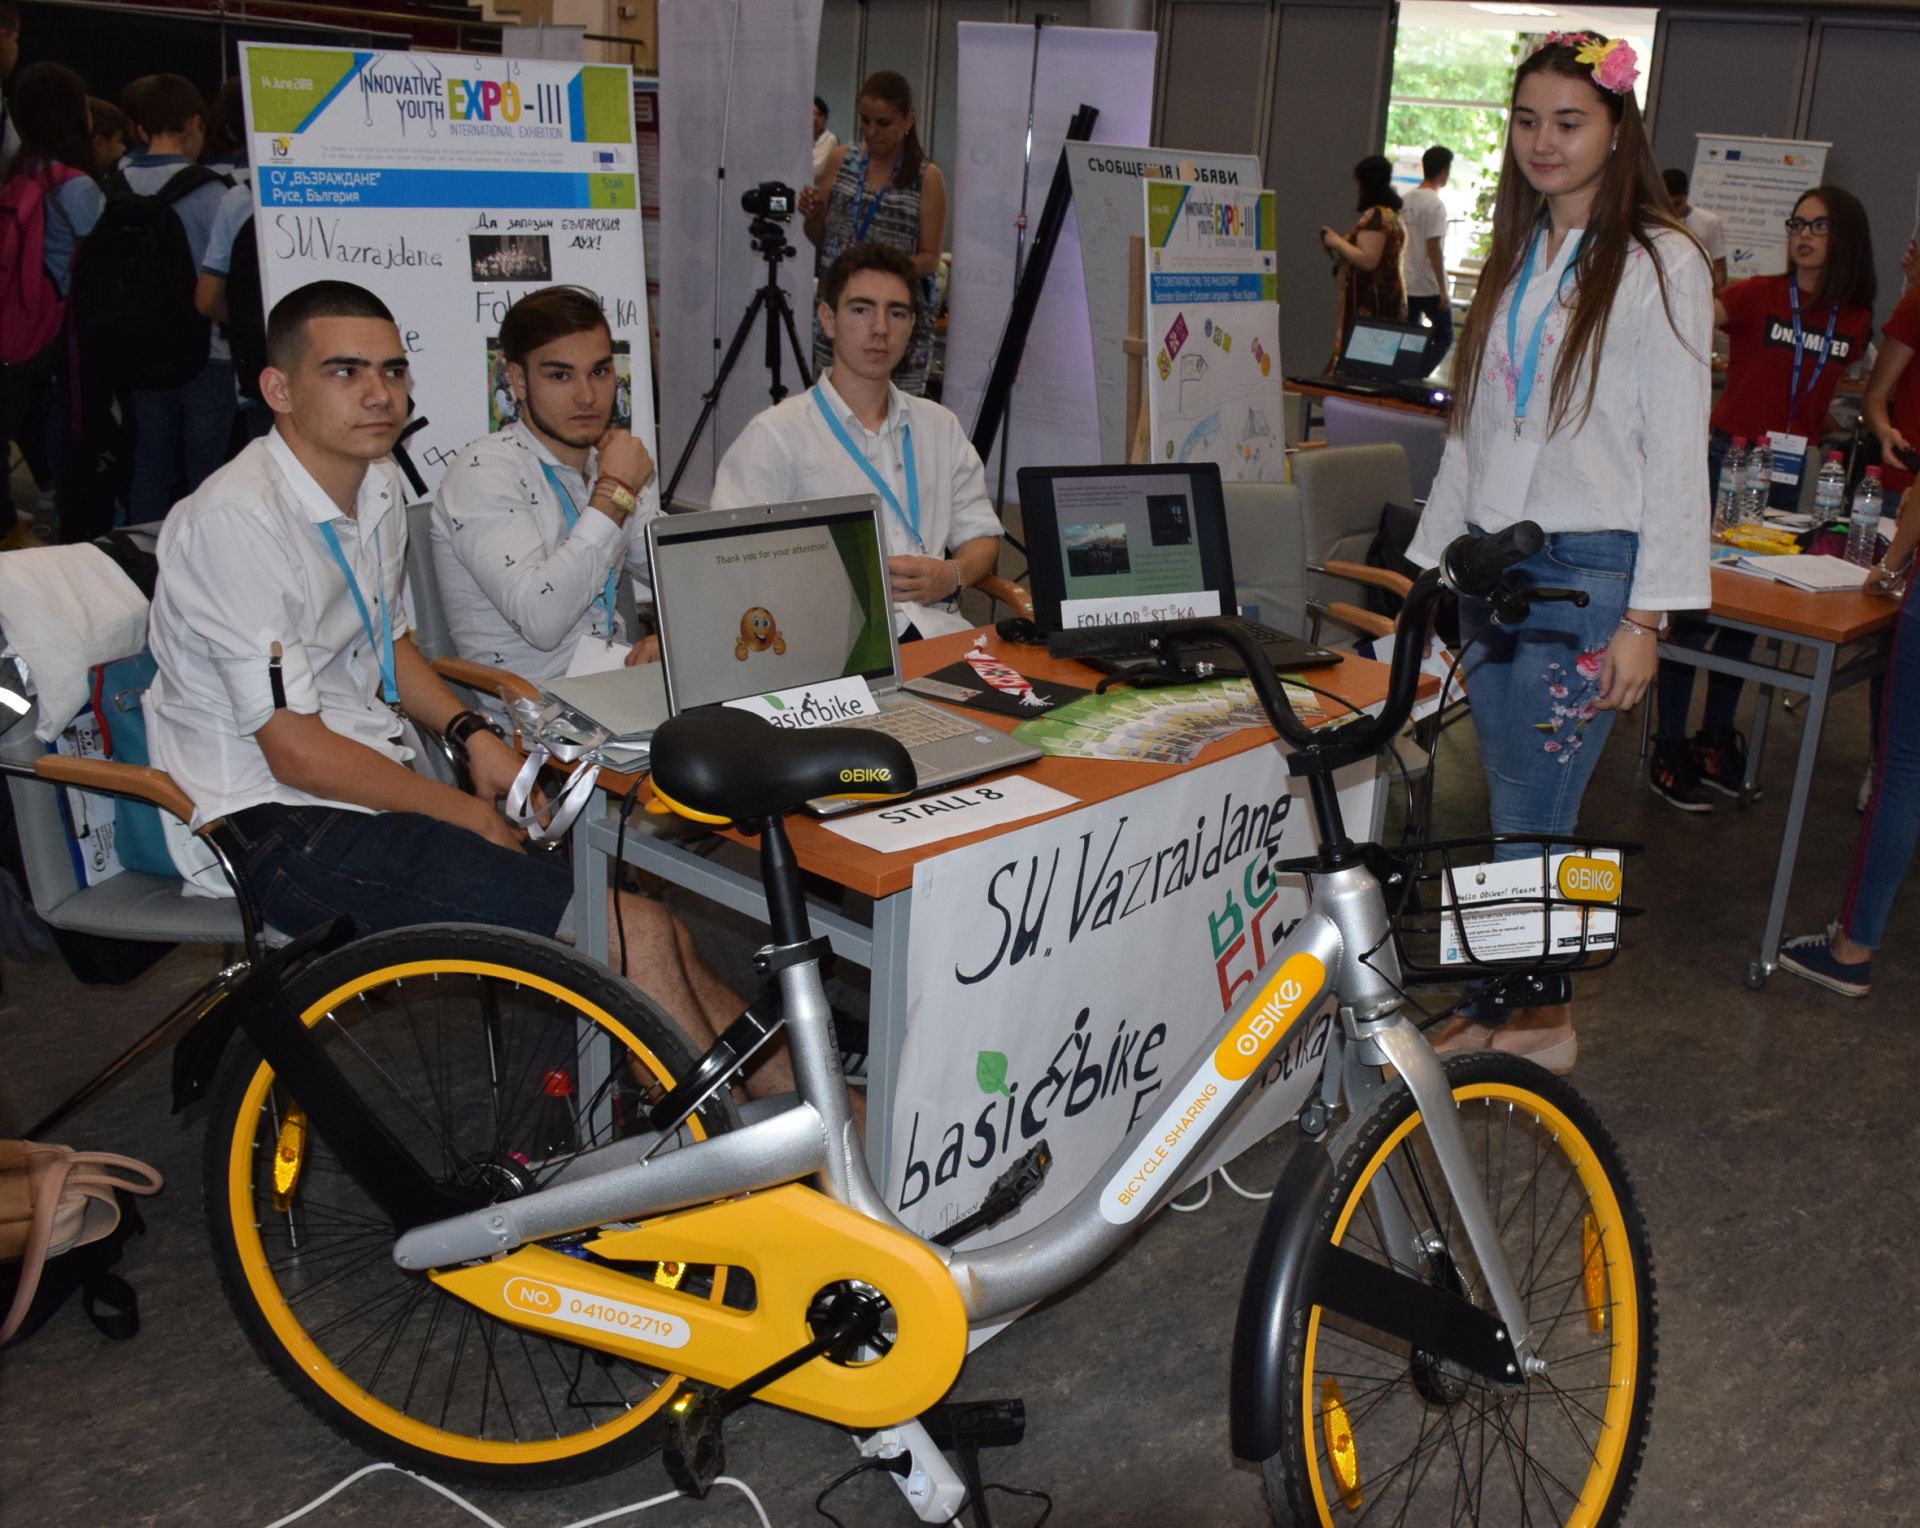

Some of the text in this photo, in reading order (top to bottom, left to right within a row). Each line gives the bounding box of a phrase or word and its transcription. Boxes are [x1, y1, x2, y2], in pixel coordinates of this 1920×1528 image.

[261, 77, 271, 88] 14
[272, 77, 292, 89] June
[360, 70, 443, 96] INNOVATIVE
[396, 99, 445, 121] YOUTH
[449, 124, 564, 139] INTERNATIONAL EXHIBITION
[271, 171, 286, 185] СУ
[1088, 157, 1173, 180] СЪОБЩЕЯ
[601, 177, 623, 190] Stall
[272, 188, 359, 204] Русе, България
[1770, 323, 1850, 358] UNIMIED
[716, 553, 740, 565] Thank
[742, 551, 758, 562] you
[760, 550, 771, 560] for
[773, 548, 790, 558] your
[878, 788, 1004, 825] STALL 8
[1512, 886, 1537, 895] Please
[1117, 1145, 1169, 1206] BICYCLE
[1164, 1083, 1218, 1148] SHARING
[519, 1286, 673, 1337] NO. 041002719
